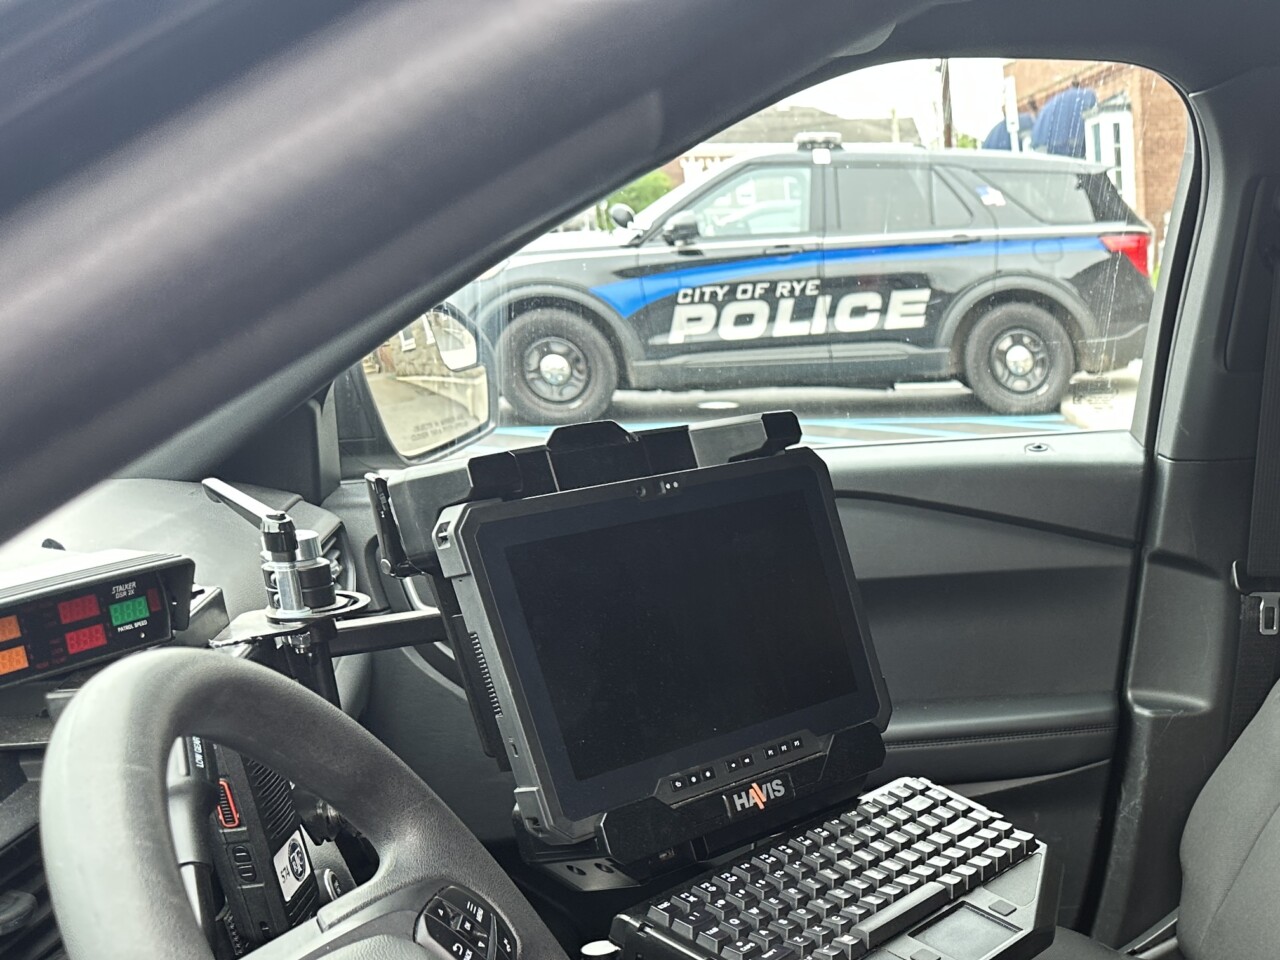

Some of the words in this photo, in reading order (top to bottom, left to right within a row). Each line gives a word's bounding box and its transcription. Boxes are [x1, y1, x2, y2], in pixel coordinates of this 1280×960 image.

[676, 285, 730, 304] CITY
[736, 283, 771, 300] OF
[775, 279, 821, 297] RYE
[667, 288, 932, 344] POLICE
[112, 581, 137, 594] STALKER
[117, 624, 134, 632] PATROL
[133, 619, 148, 628] SPEED
[195, 752, 204, 768] LOW
[732, 779, 786, 812] HAVIS
